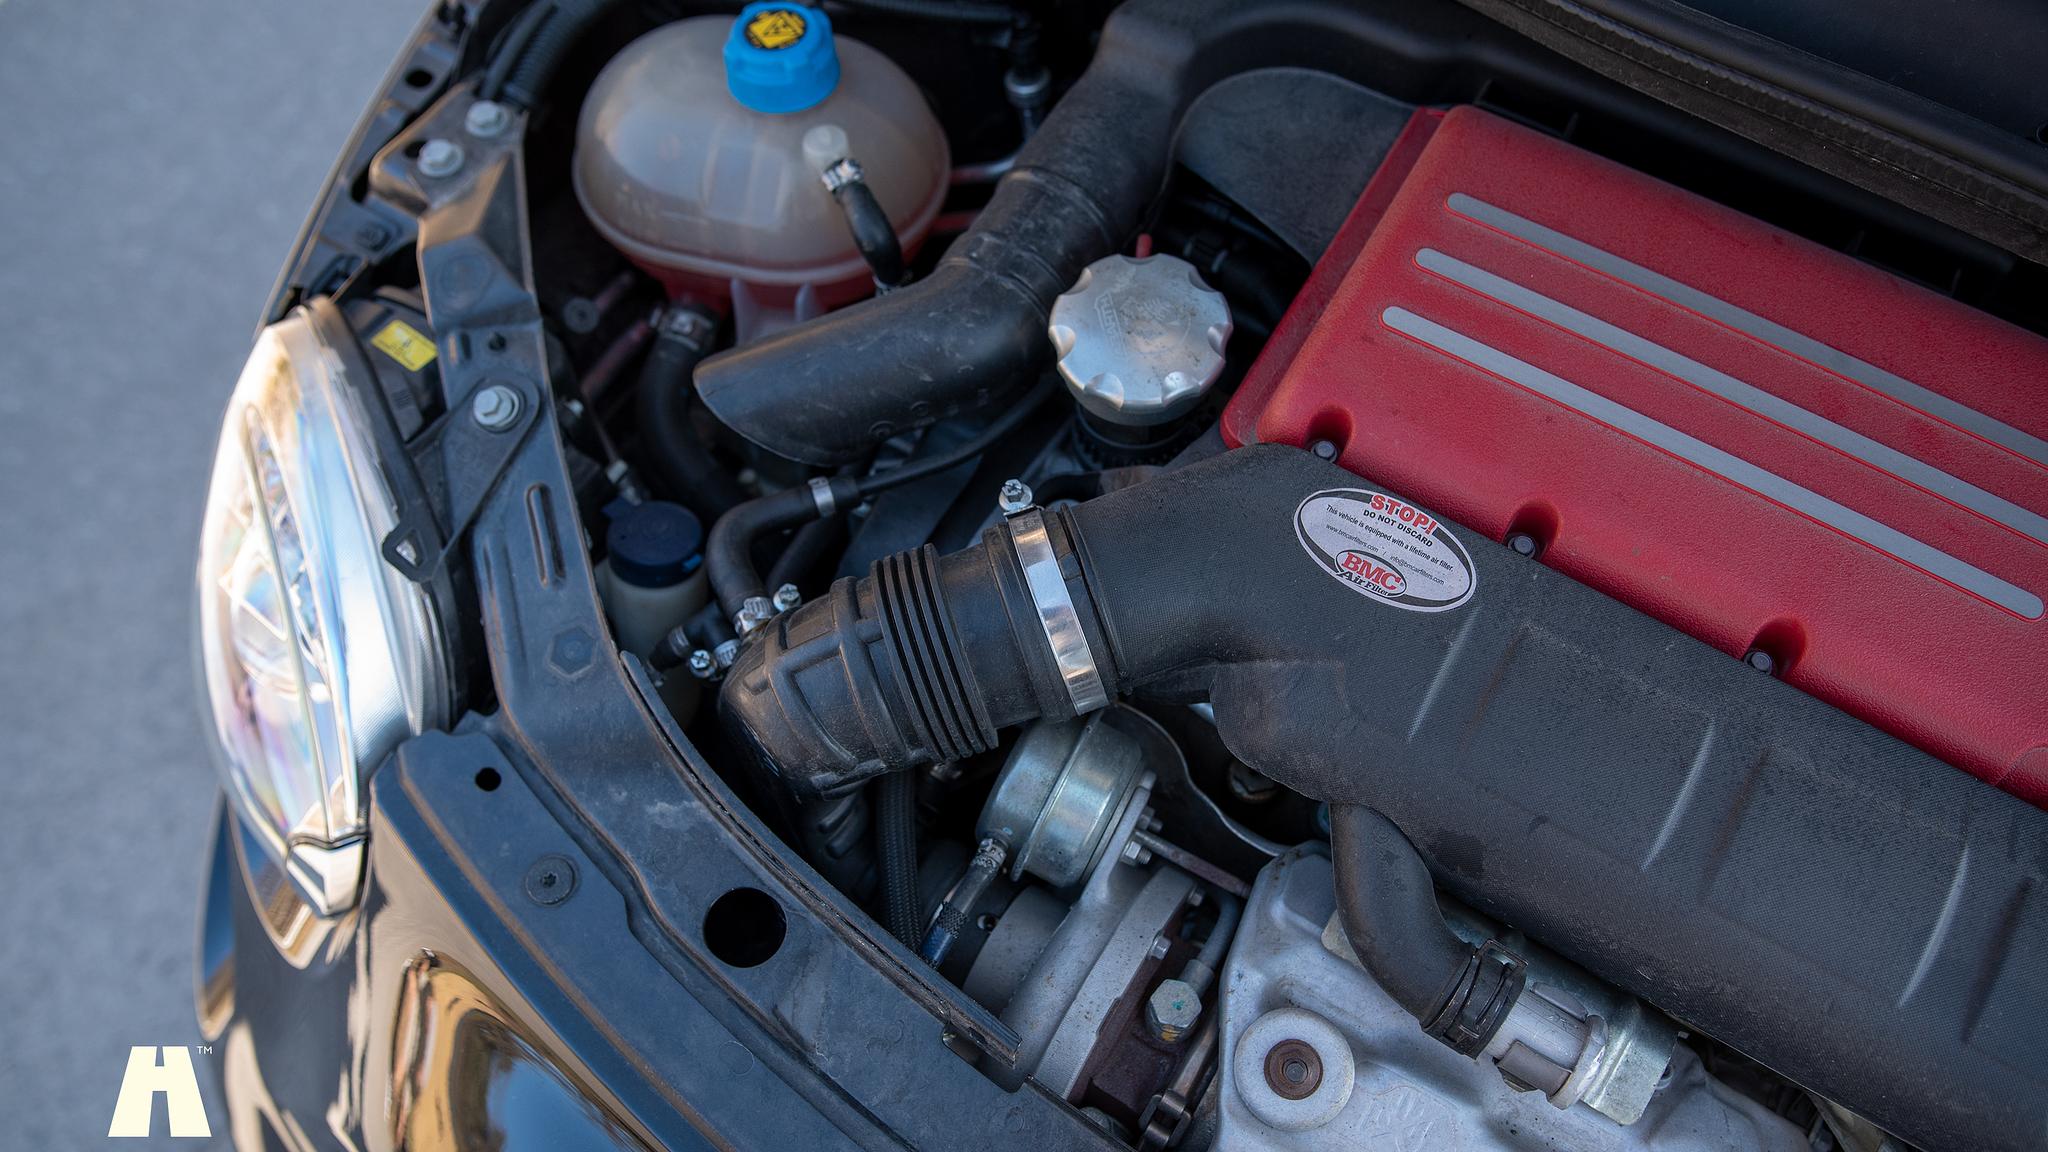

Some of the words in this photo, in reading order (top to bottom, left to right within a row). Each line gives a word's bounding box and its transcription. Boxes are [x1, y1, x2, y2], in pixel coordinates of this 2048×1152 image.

[1363, 509, 1376, 519] DO
[1377, 514, 1397, 527] NOT
[1397, 523, 1433, 547] DISCARD
[1371, 494, 1437, 535] STOP!
[1326, 504, 1338, 515] This
[1338, 511, 1359, 525] vehicle
[1358, 520, 1364, 528] is
[1364, 524, 1392, 541] equipped
[1391, 536, 1405, 548] with
[1409, 545, 1431, 560] lifetime
[1431, 557, 1440, 565] air
[1336, 571, 1365, 585] Air
[1364, 581, 1388, 596] Filter
[1341, 552, 1402, 590] BMC
